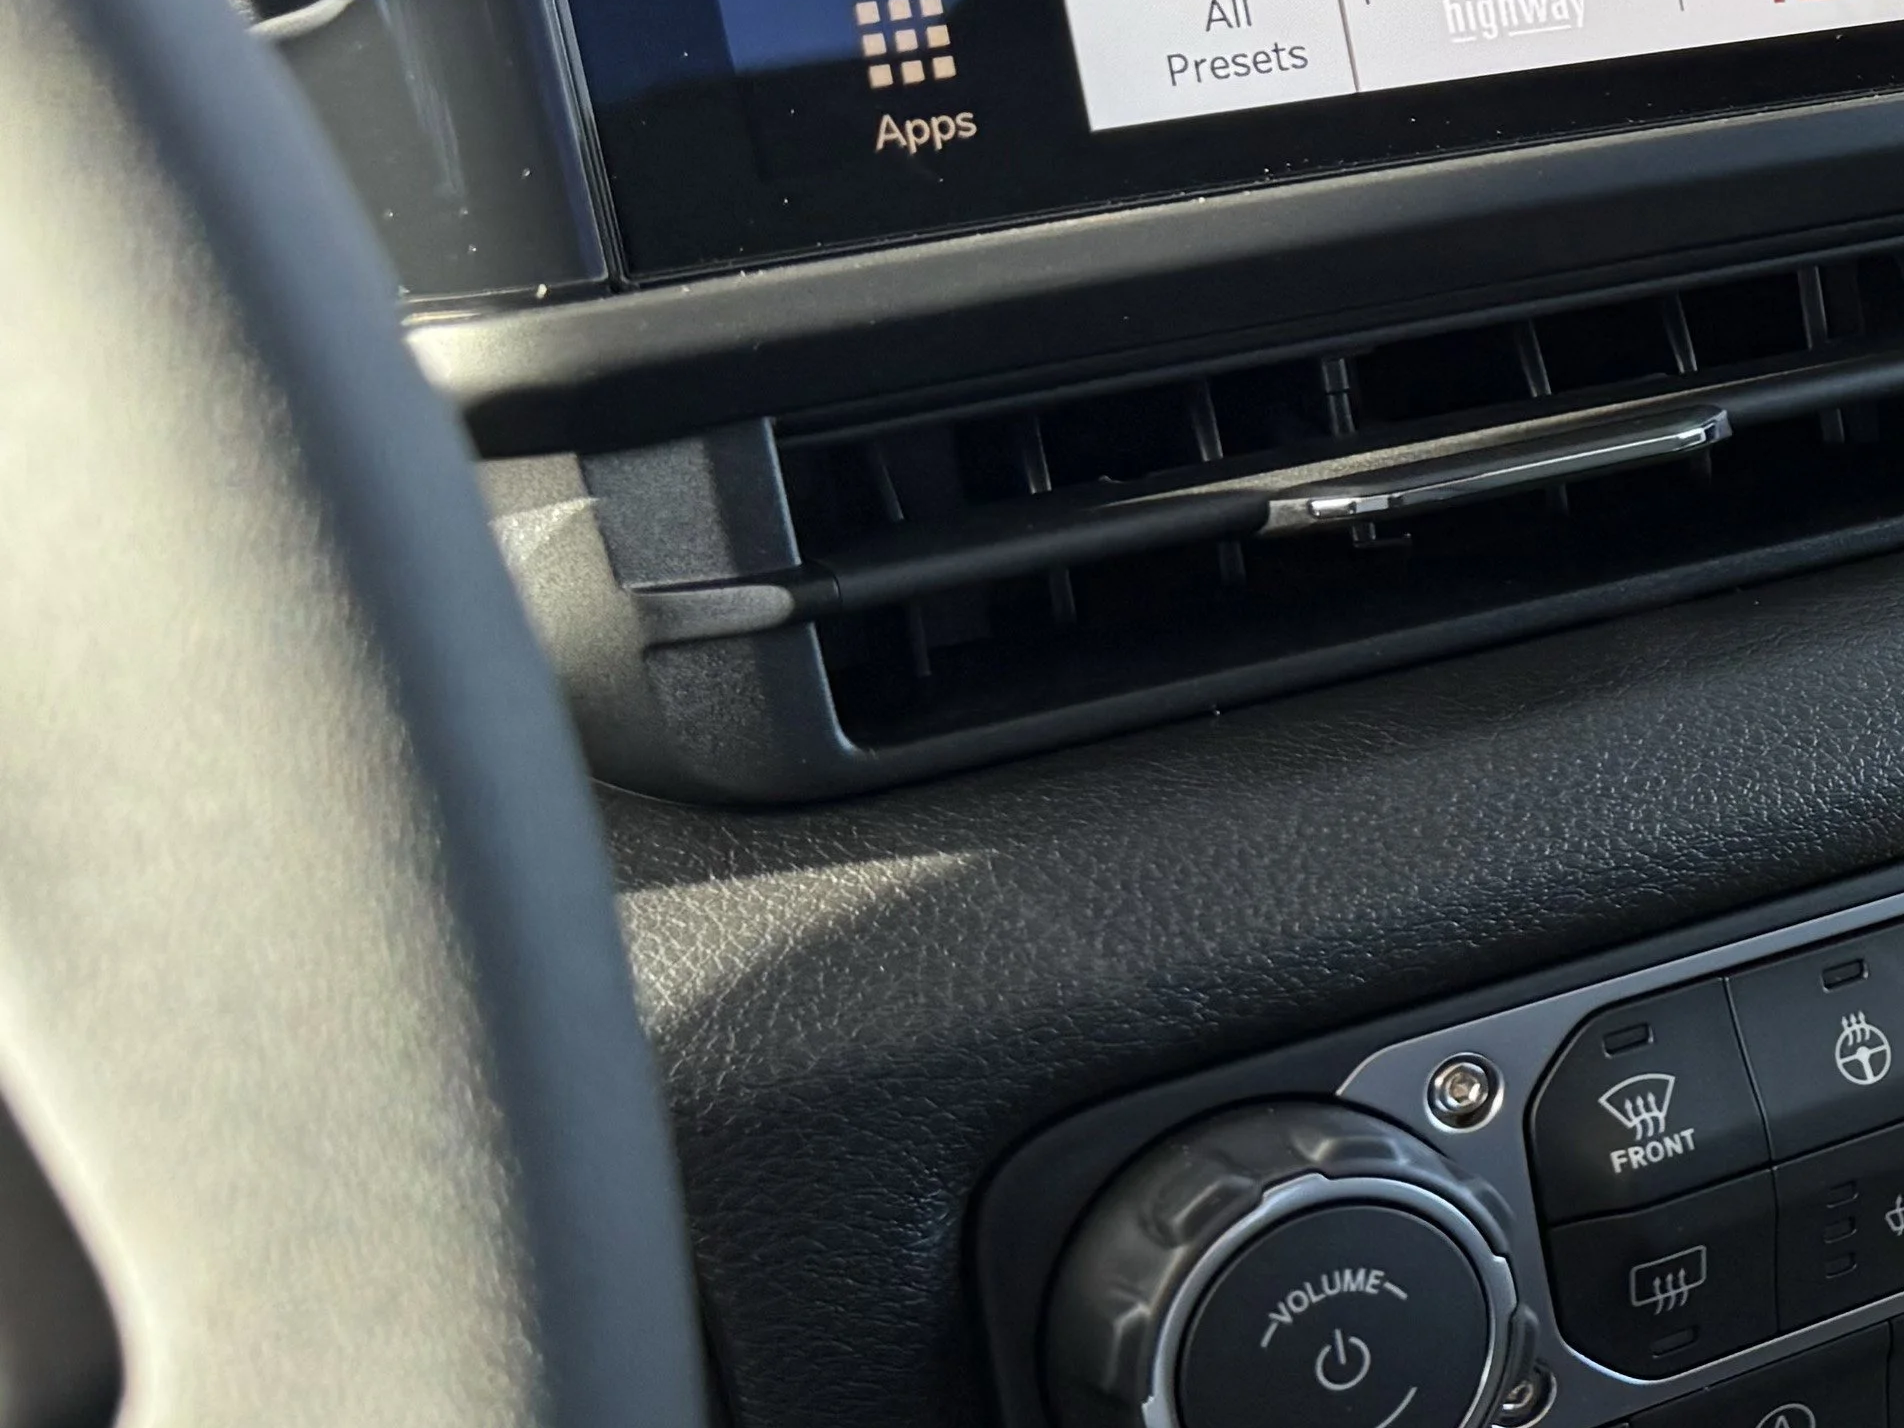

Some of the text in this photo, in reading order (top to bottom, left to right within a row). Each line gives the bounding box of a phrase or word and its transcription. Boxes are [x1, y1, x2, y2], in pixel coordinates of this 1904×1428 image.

[1167, 39, 1309, 87] Presets
[875, 109, 978, 155] Apps
[1609, 1126, 1697, 1174] FRONT
[1268, 1267, 1386, 1329] VOLUME
